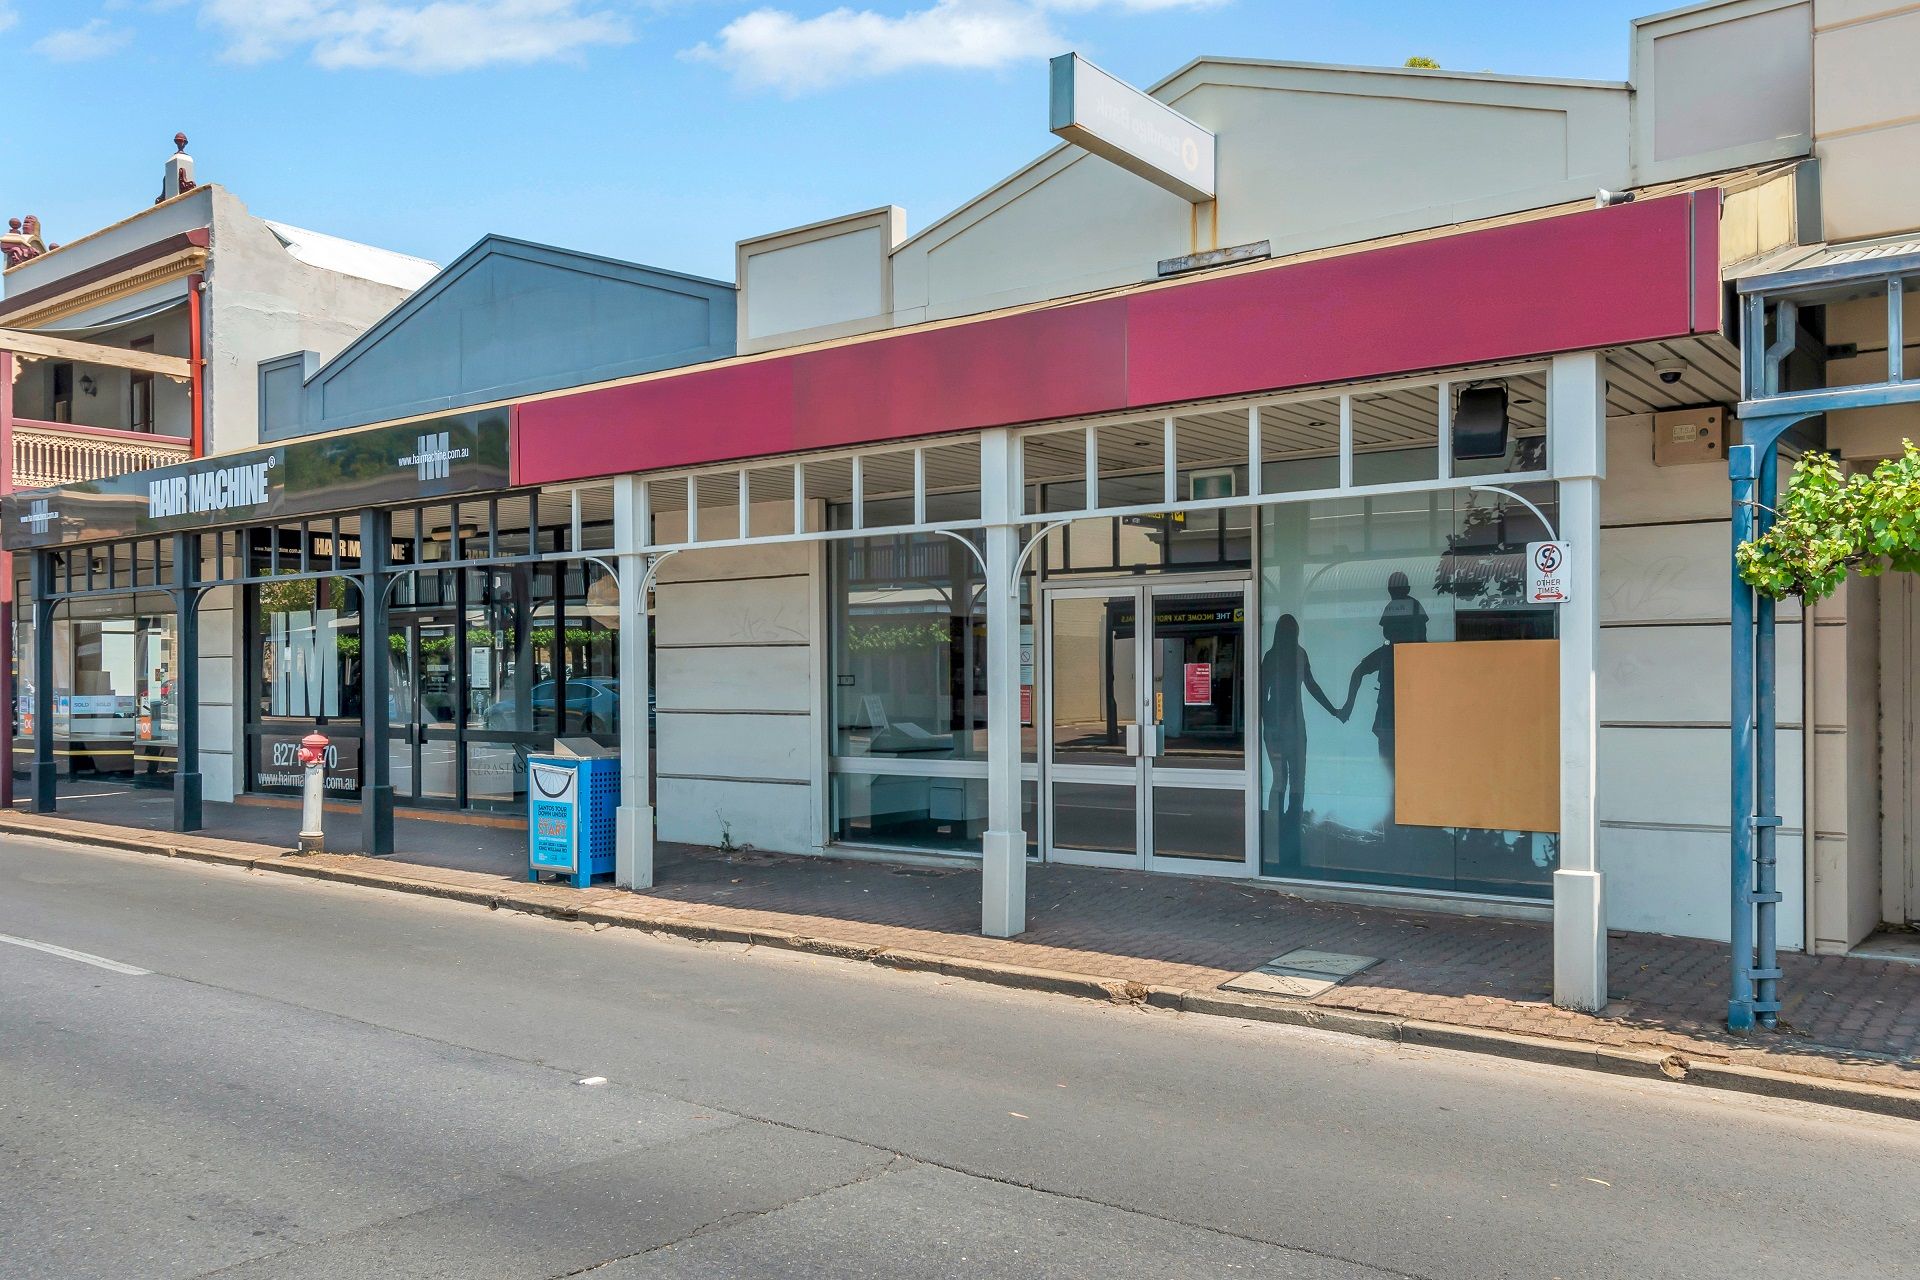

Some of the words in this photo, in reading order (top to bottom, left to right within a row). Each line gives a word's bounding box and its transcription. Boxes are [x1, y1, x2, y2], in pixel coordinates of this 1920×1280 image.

[398, 447, 469, 467] www.hairmachine.com.au
[149, 476, 188, 518] HAIR
[189, 462, 269, 513] MACHINE
[314, 537, 346, 556] HAR
[1536, 578, 1561, 587] OTHER
[1538, 586, 1560, 594] TIMES
[258, 771, 355, 791] www.hairma.com.au
[538, 823, 567, 837] START
